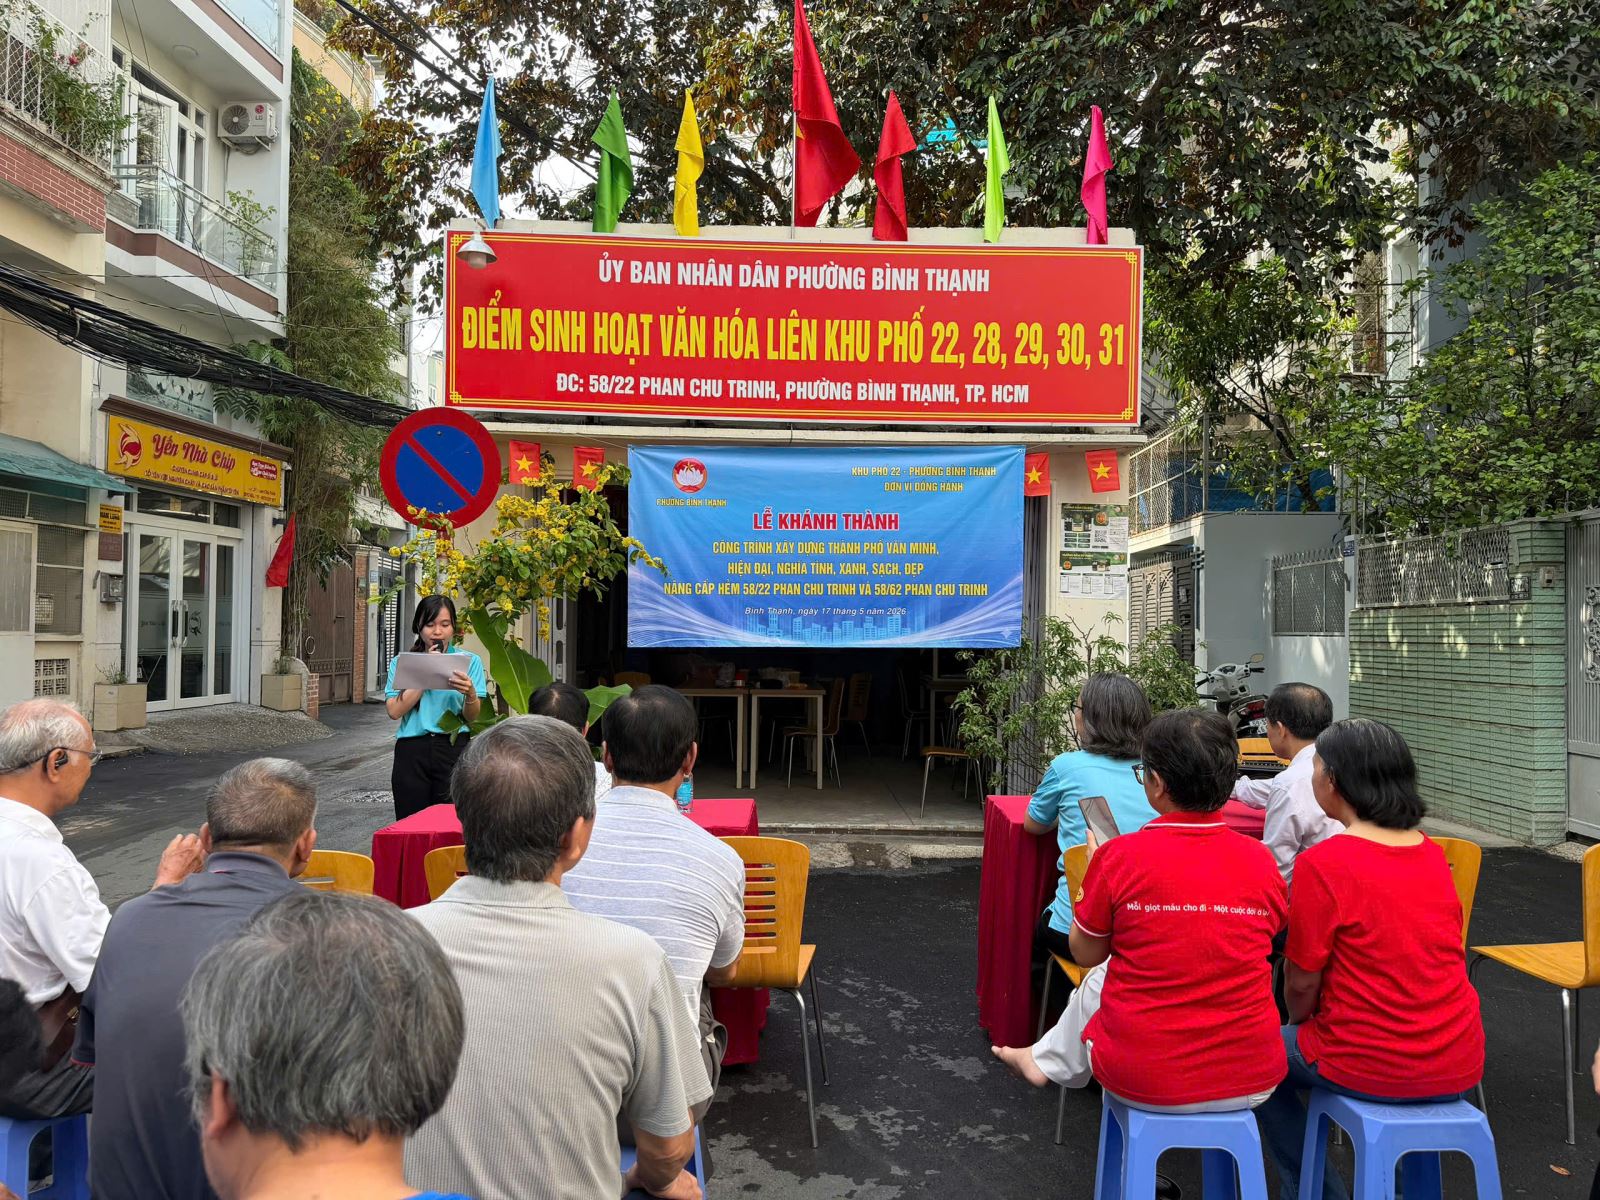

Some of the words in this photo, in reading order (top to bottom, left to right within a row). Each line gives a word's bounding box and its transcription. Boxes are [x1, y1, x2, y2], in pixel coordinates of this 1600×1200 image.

[599, 252, 624, 283] ỦY
[630, 260, 671, 285] BAN
[677, 258, 732, 287] NHÂN
[739, 260, 779, 288] DÂN
[785, 261, 866, 291] PHƯỜNG
[872, 262, 919, 291] BÌNH
[925, 268, 990, 297] THẠNH
[462, 289, 522, 350] ĐIỂM
[530, 309, 586, 354] SINH
[594, 311, 653, 365] HOẠT
[659, 306, 706, 358] VĂN
[713, 308, 760, 360] HÓA
[767, 309, 817, 361] LIÊN
[824, 319, 871, 363] KHU
[878, 306, 925, 364] PHỐ
[930, 321, 965, 369] 22,
[972, 322, 1007, 369] 28,
[1014, 322, 1049, 370] 29,
[1056, 322, 1091, 370] 30,
[1099, 323, 1124, 366] 31
[556, 373, 584, 393] ĐC:
[588, 374, 634, 395] 58/22
[639, 376, 684, 397] PHAN
[689, 378, 722, 397] CHU
[727, 379, 781, 401] TRINH,
[785, 378, 852, 401] PHƯỜNG
[857, 379, 896, 402] BÌNH
[901, 383, 960, 405] THẠNH,
[965, 384, 986, 403] TP.
[992, 385, 1029, 403] HCM
[152, 433, 179, 459] Yến
[182, 441, 209, 464] Nhà
[211, 449, 236, 473] Chip
[851, 466, 869, 476] KHU
[891, 467, 901, 476] 22
[909, 464, 944, 476] PHƯỜNG
[969, 466, 997, 478] THẠNH
[752, 507, 773, 531] LỄ
[778, 508, 837, 531] KHÁNH
[842, 510, 899, 531] THÀNH
[712, 540, 740, 554] CÔNG
[743, 540, 772, 554] TRÌNH
[775, 540, 794, 554] XÂY
[797, 541, 825, 556] DỰNG
[828, 540, 860, 554] THÀNH
[864, 539, 884, 554] PHỐ
[909, 543, 939, 555] MINH,
[728, 561, 751, 576] HIỆN
[754, 562, 774, 576] ĐẠI,
[777, 561, 807, 575] NGHĨA
[839, 563, 869, 576] XANH,
[872, 563, 902, 578] SẠCH,
[904, 563, 924, 578] ĐẸP
[664, 580, 692, 595] NÂNG
[694, 578, 715, 595] CẤP
[718, 577, 740, 595] HẺM
[743, 583, 771, 595] 58/22
[773, 583, 801, 595] PHAN
[804, 583, 824, 595] CHU
[827, 583, 856, 595] TRINH
[859, 581, 871, 596] VÀ
[874, 583, 902, 596] 58/62
[905, 583, 932, 596] PHAN
[935, 583, 955, 596] CHU
[958, 583, 988, 596] TRINH
[822, 607, 831, 615] 17
[859, 607, 864, 615] 5
[887, 607, 907, 615] 2026
[1127, 901, 1142, 911] Mỗi
[1144, 902, 1161, 913] giọt
[1163, 902, 1181, 911] máu
[1183, 903, 1198, 912] cho
[1199, 903, 1207, 912] đi
[1213, 904, 1229, 915] Một
[1230, 906, 1246, 916] cuộc
